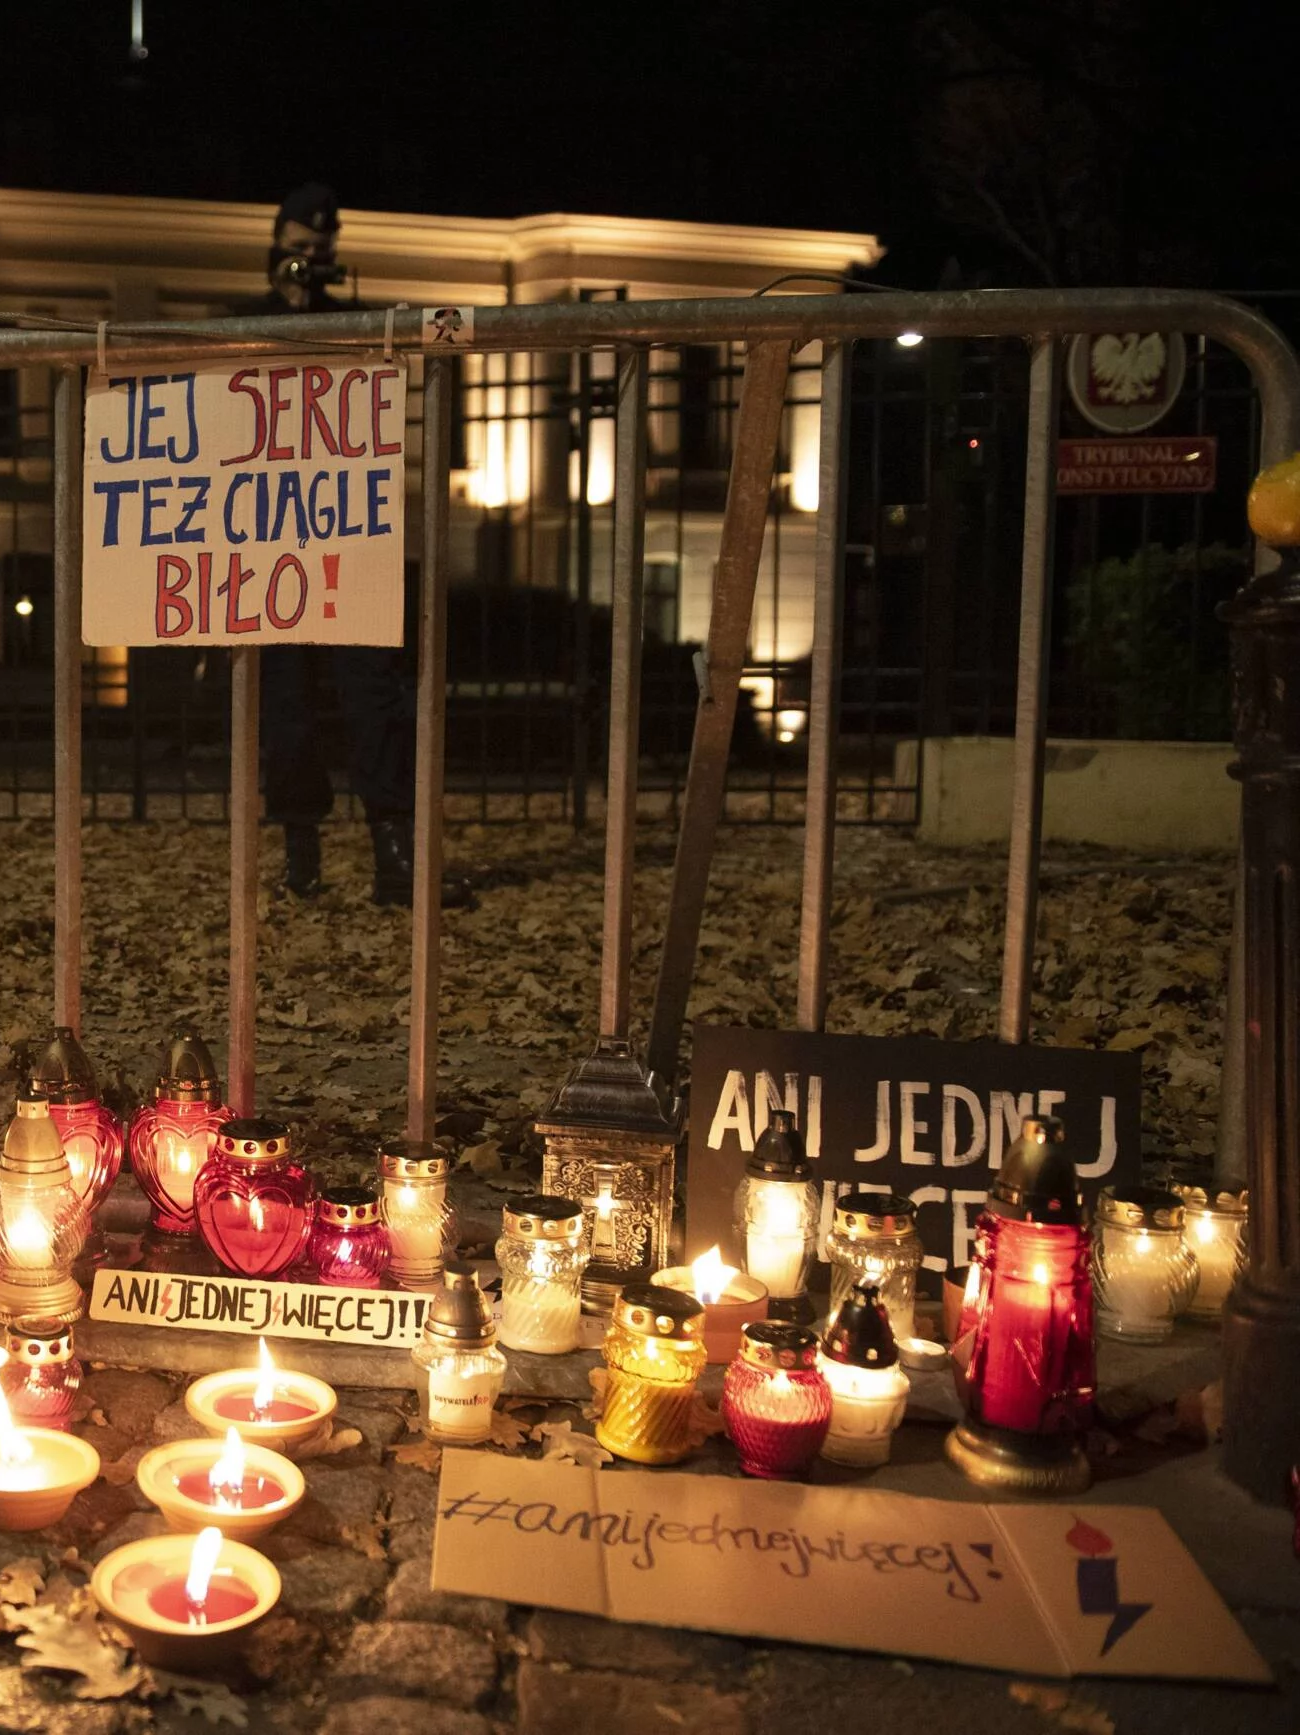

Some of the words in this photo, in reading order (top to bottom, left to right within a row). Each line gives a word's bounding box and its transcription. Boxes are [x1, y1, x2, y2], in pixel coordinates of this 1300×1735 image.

[100, 372, 199, 464] JEJ
[220, 366, 402, 466] SERCE
[223, 468, 392, 549] CIĄGLE
[1058, 466, 1208, 487] ONSTYTUCYJNY
[154, 552, 341, 639] BIŁO!
[707, 1069, 822, 1158] ANI
[103, 1275, 158, 1316] ANI
[166, 1278, 272, 1329] JEDNEJ
[282, 1292, 434, 1339] WIĘCEJ!!
